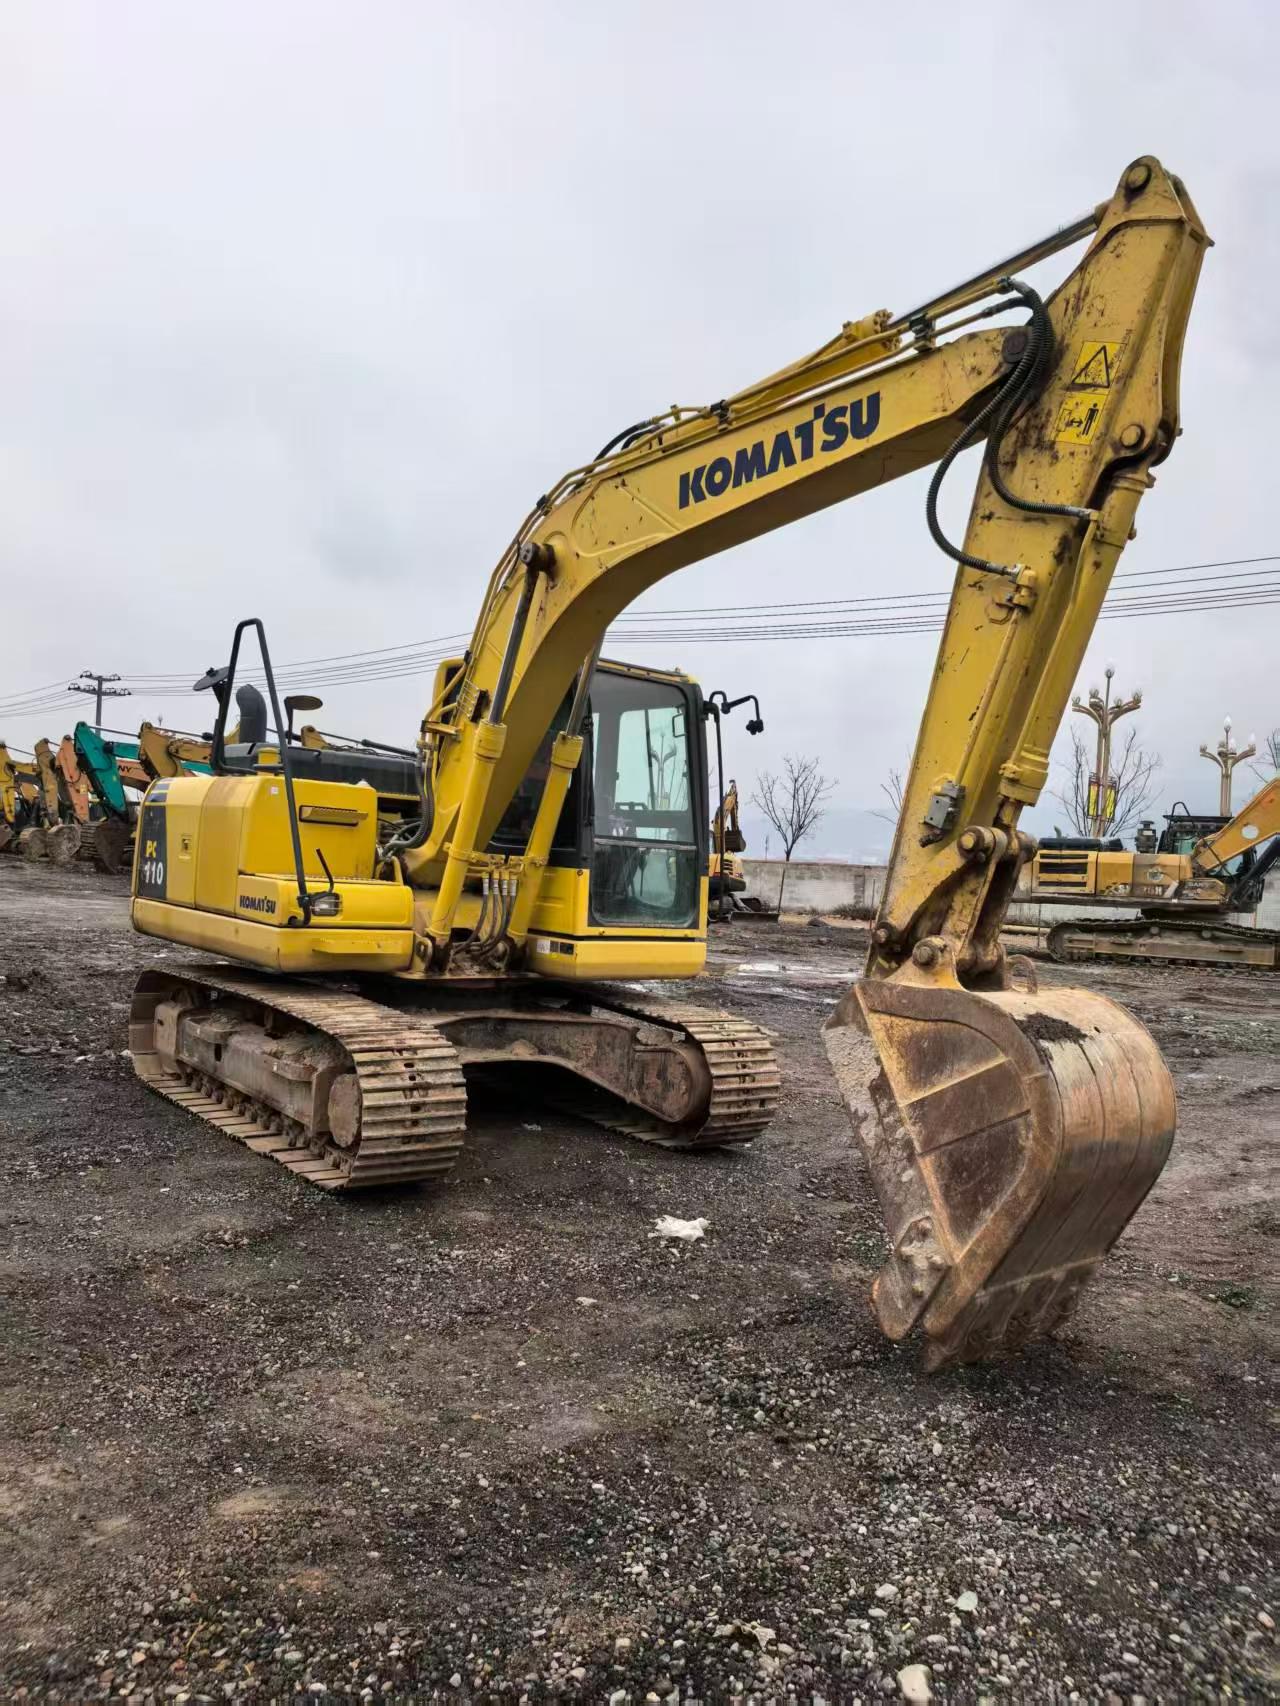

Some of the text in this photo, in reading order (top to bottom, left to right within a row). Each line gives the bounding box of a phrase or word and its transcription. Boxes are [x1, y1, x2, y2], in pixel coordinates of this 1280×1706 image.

[679, 391, 881, 510] KOMATSU
[145, 840, 158, 858] PC
[144, 861, 164, 884] 110
[239, 895, 277, 914] KOMATSU
